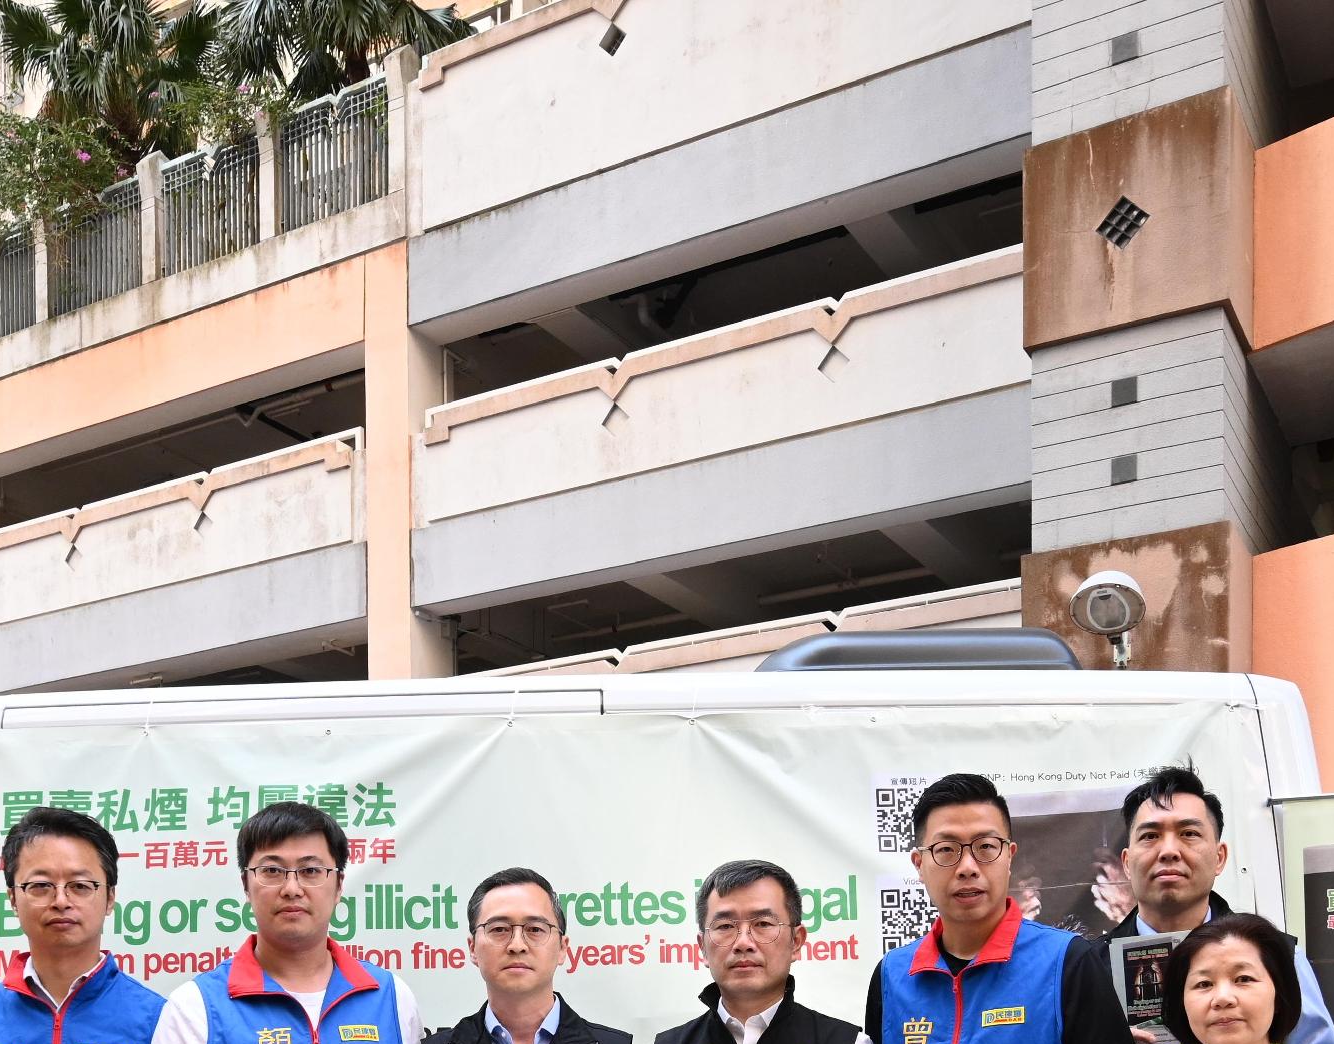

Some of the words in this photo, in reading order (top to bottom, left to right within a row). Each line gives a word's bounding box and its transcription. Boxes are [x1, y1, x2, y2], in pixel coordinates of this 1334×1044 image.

[1010, 771, 1035, 783] Hong
[1038, 769, 1062, 783] Kong
[1065, 770, 1087, 782] Duty
[1090, 771, 1107, 780] Not
[1110, 770, 1130, 780] Paid
[159, 896, 208, 932] or
[366, 883, 458, 930] illicit
[412, 942, 465, 971] fine
